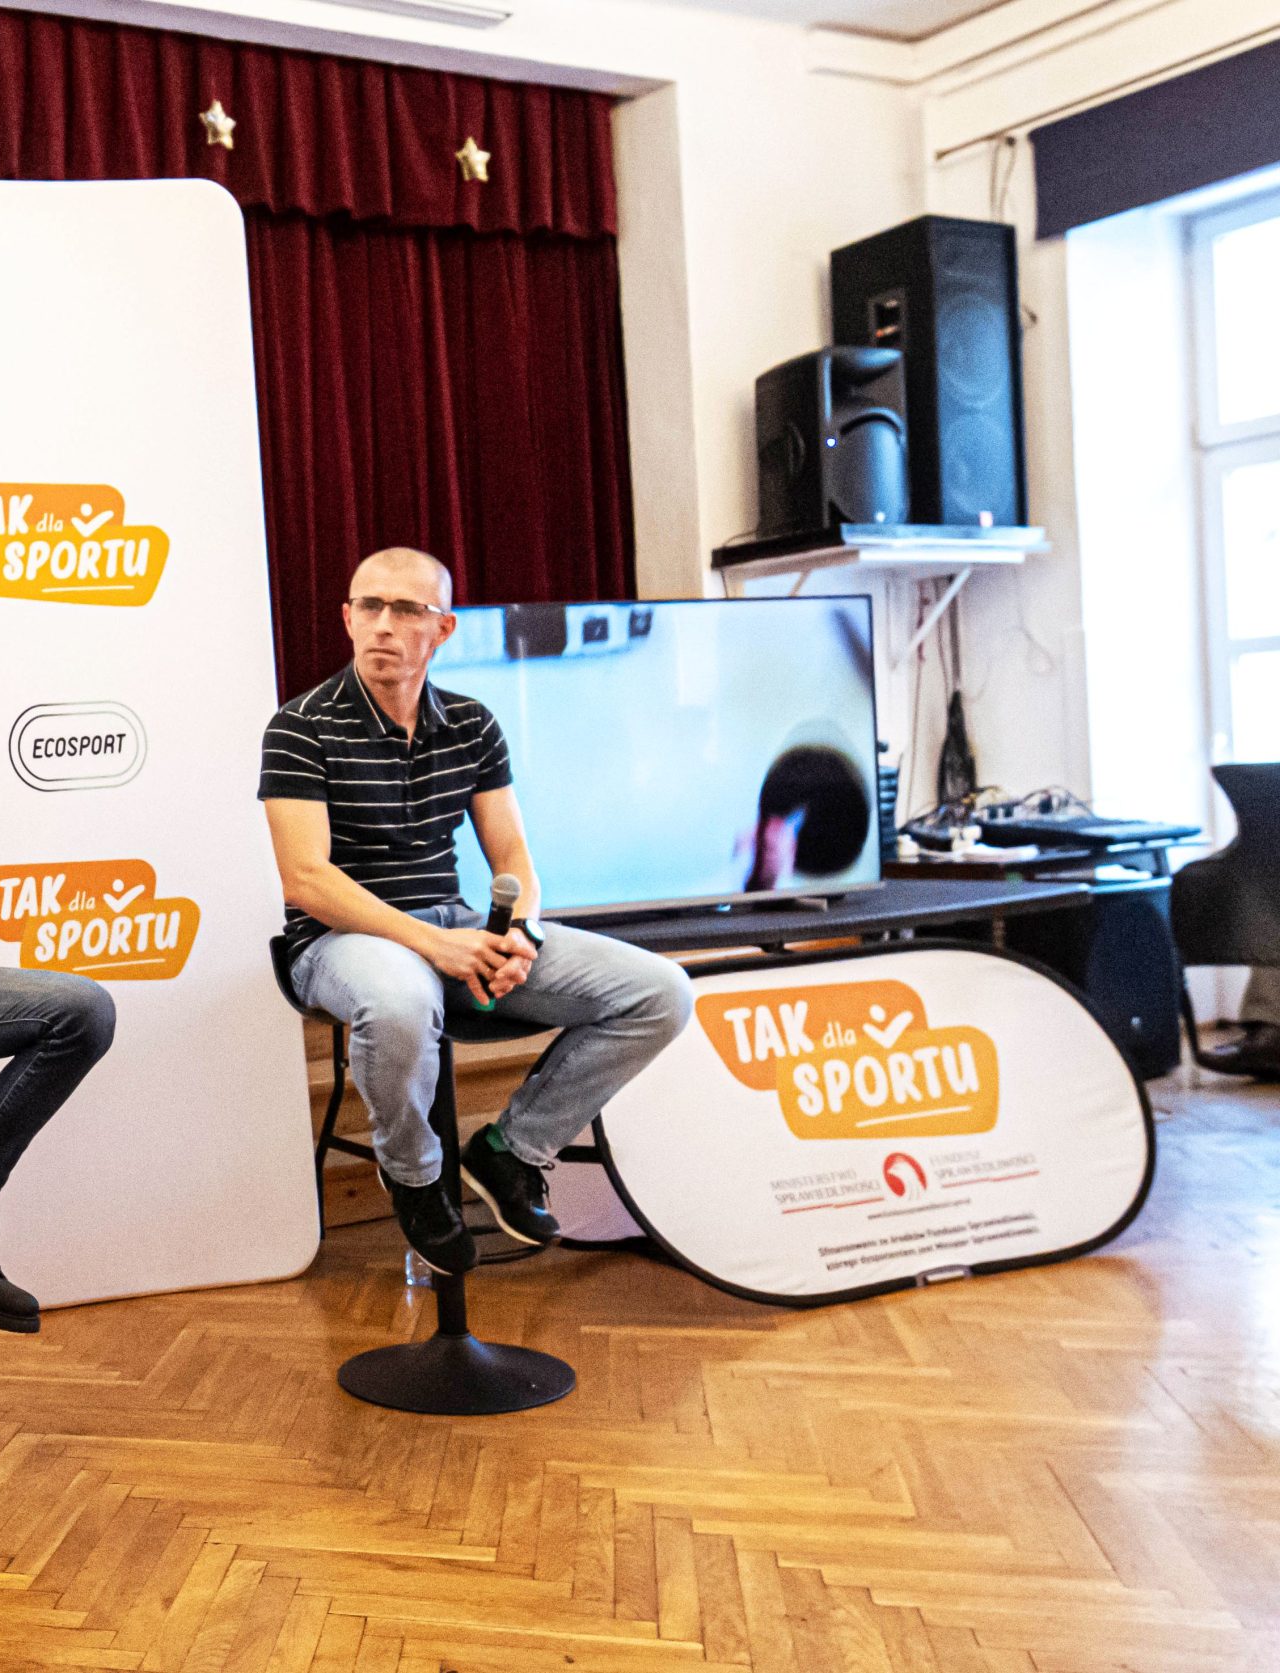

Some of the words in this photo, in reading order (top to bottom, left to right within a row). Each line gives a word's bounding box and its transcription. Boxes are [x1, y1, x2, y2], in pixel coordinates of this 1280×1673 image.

[35, 513, 64, 533] dla
[2, 537, 151, 582] SPORTU
[31, 733, 127, 759] ECOSPORT
[68, 889, 97, 913] dla
[34, 910, 181, 963] SPORTU
[723, 1000, 816, 1064] TAK
[822, 1021, 858, 1049] dla
[792, 1042, 981, 1118] SPORTU
